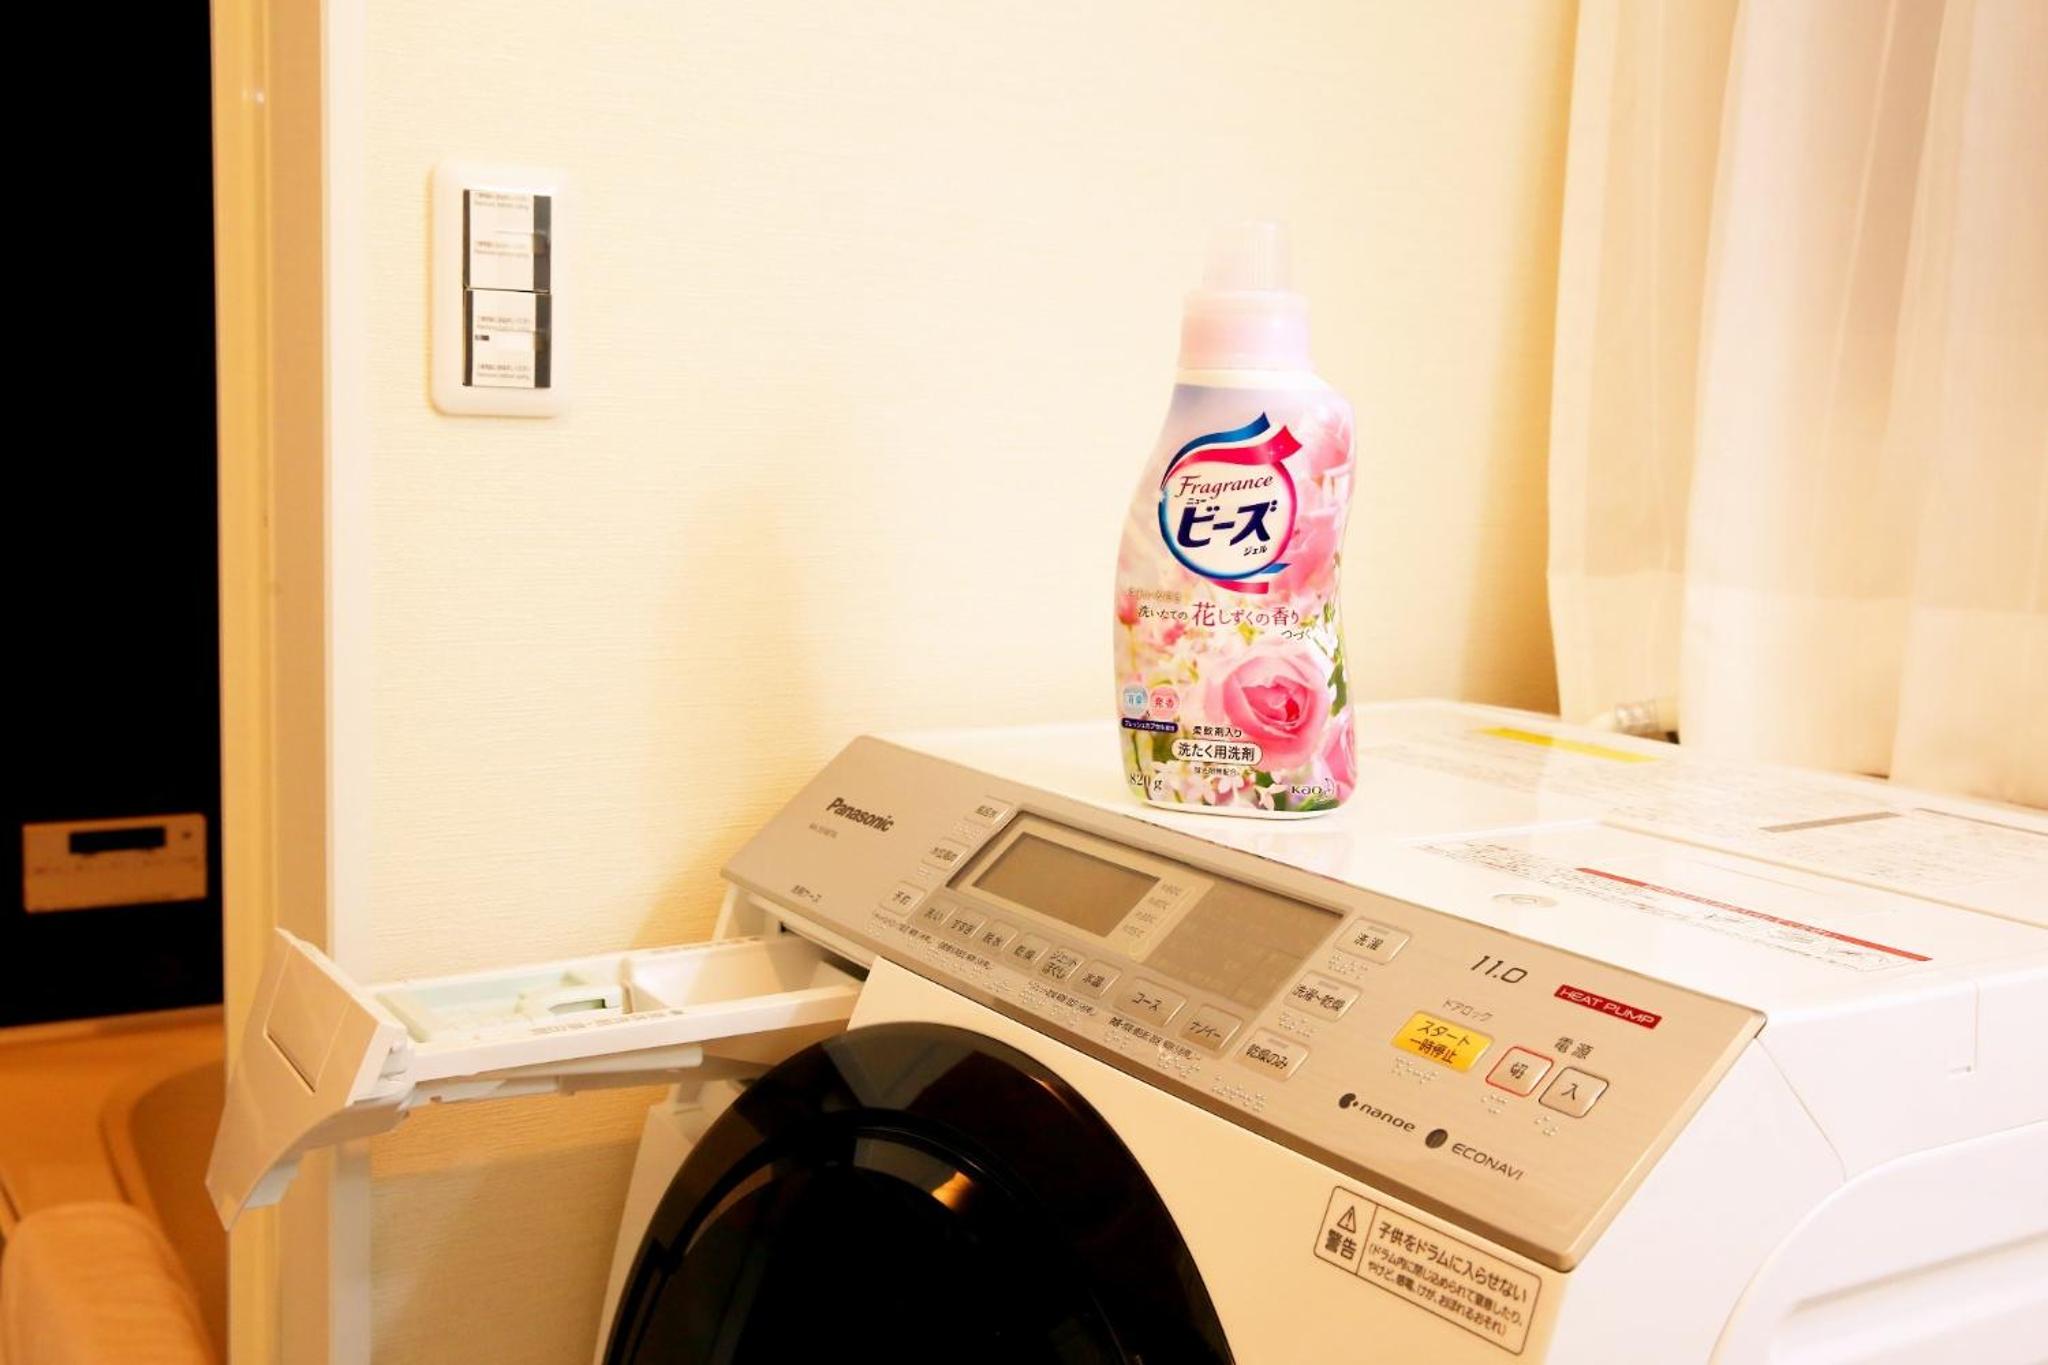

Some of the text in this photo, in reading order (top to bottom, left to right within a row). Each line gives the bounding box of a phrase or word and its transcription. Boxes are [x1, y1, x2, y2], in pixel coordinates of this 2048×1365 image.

[1174, 474, 1274, 499] Fragrance
[1176, 499, 1279, 549] ビーズ
[1243, 545, 1268, 557] ジェル
[1192, 725, 1243, 739] 柔軟剤入り
[1177, 742, 1256, 763] 洗たく用洗剤
[1130, 773, 1164, 792] 820 g
[825, 796, 896, 833] Panasonic
[1469, 954, 1530, 985] 11.0
[1132, 991, 1163, 1013] コース
[1440, 998, 1494, 1024] ドアロック
[1557, 987, 1658, 1027] HEAT PUMP
[1417, 1019, 1472, 1048] スタート
[1409, 1037, 1458, 1065] 一時停止
[1554, 1036, 1595, 1062] 電源
[1509, 1063, 1527, 1081] 切
[1561, 1083, 1581, 1101] 入
[1358, 1100, 1416, 1135] nanoe
[1451, 1141, 1525, 1182] ECONAVI
[1324, 1227, 1358, 1261] 警告
[1378, 1220, 1529, 1304] 子供をドラムに入らせない
[1369, 1243, 1523, 1328] （ドラム内に閉じ込められてしたり、
